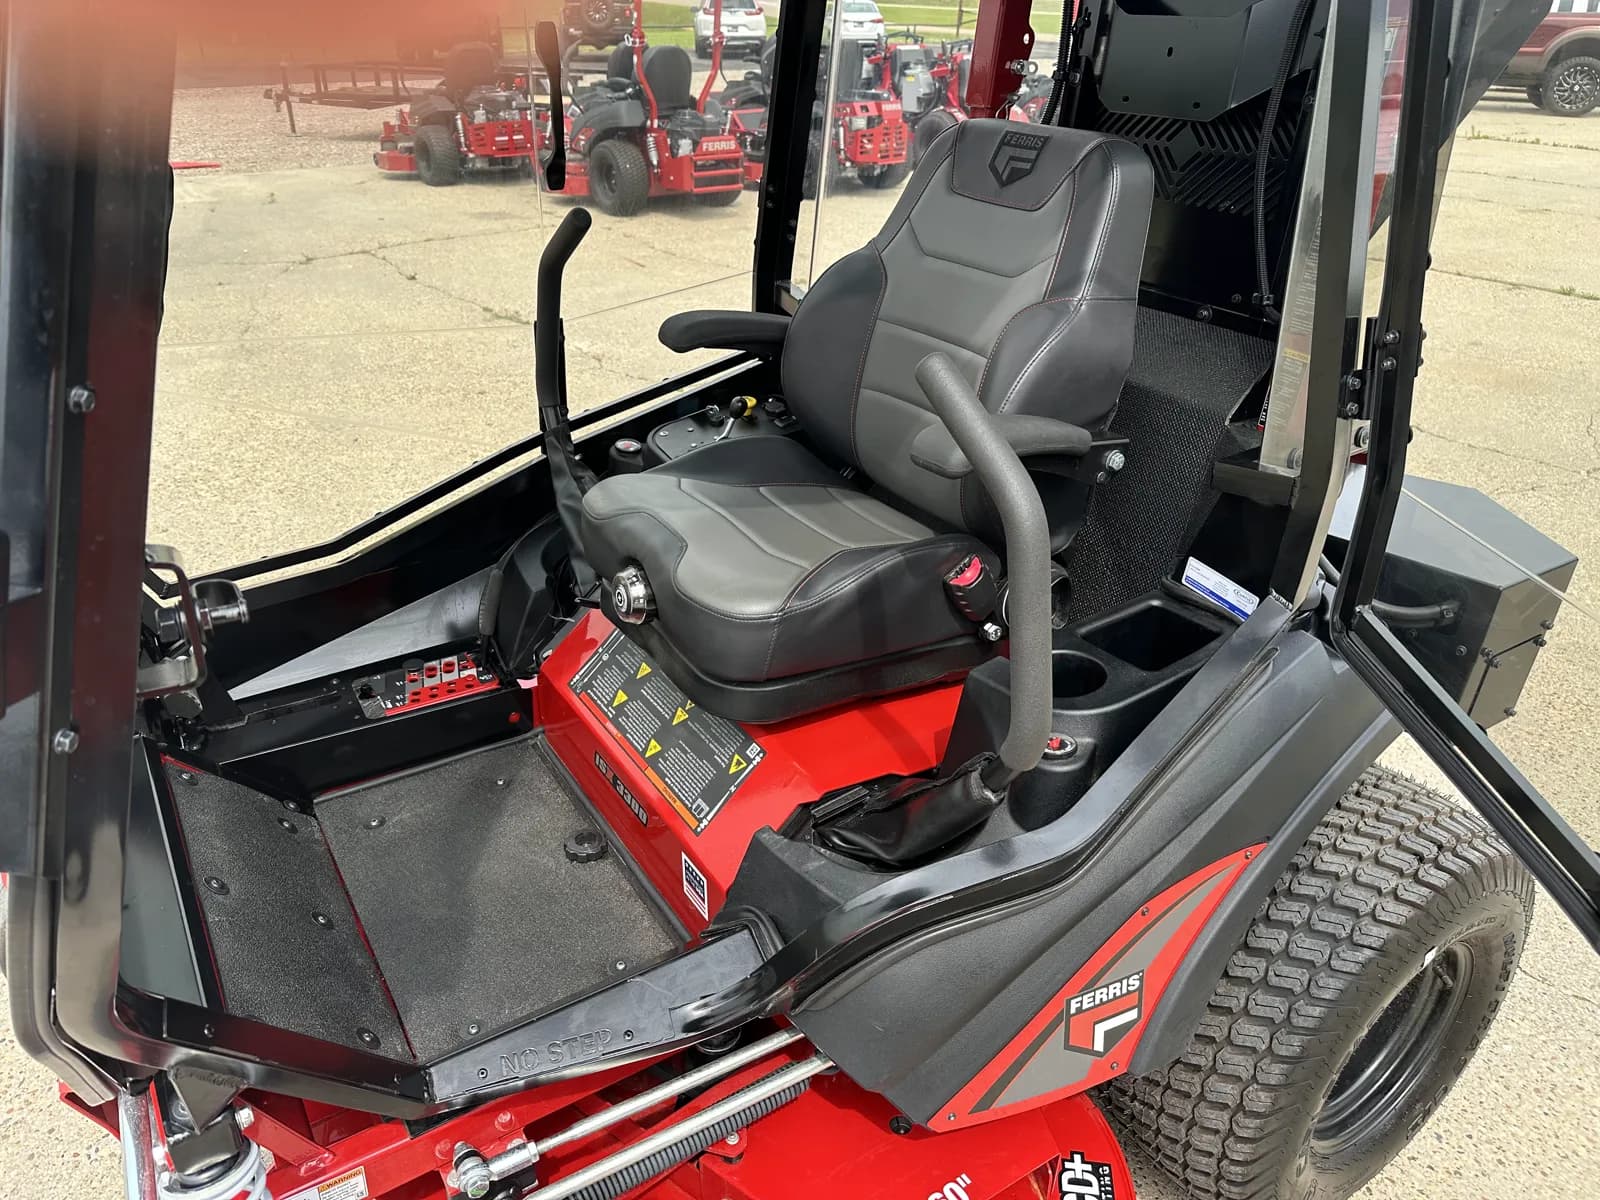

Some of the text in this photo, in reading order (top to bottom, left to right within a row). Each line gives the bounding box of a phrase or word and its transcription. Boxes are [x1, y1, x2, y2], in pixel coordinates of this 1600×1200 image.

[702, 140, 736, 152] FERRIS
[1003, 132, 1045, 149] FERRIS
[1069, 974, 1141, 1015] FERRIS
[500, 1028, 613, 1077] NO STEP
[326, 1168, 363, 1189] WARNING
